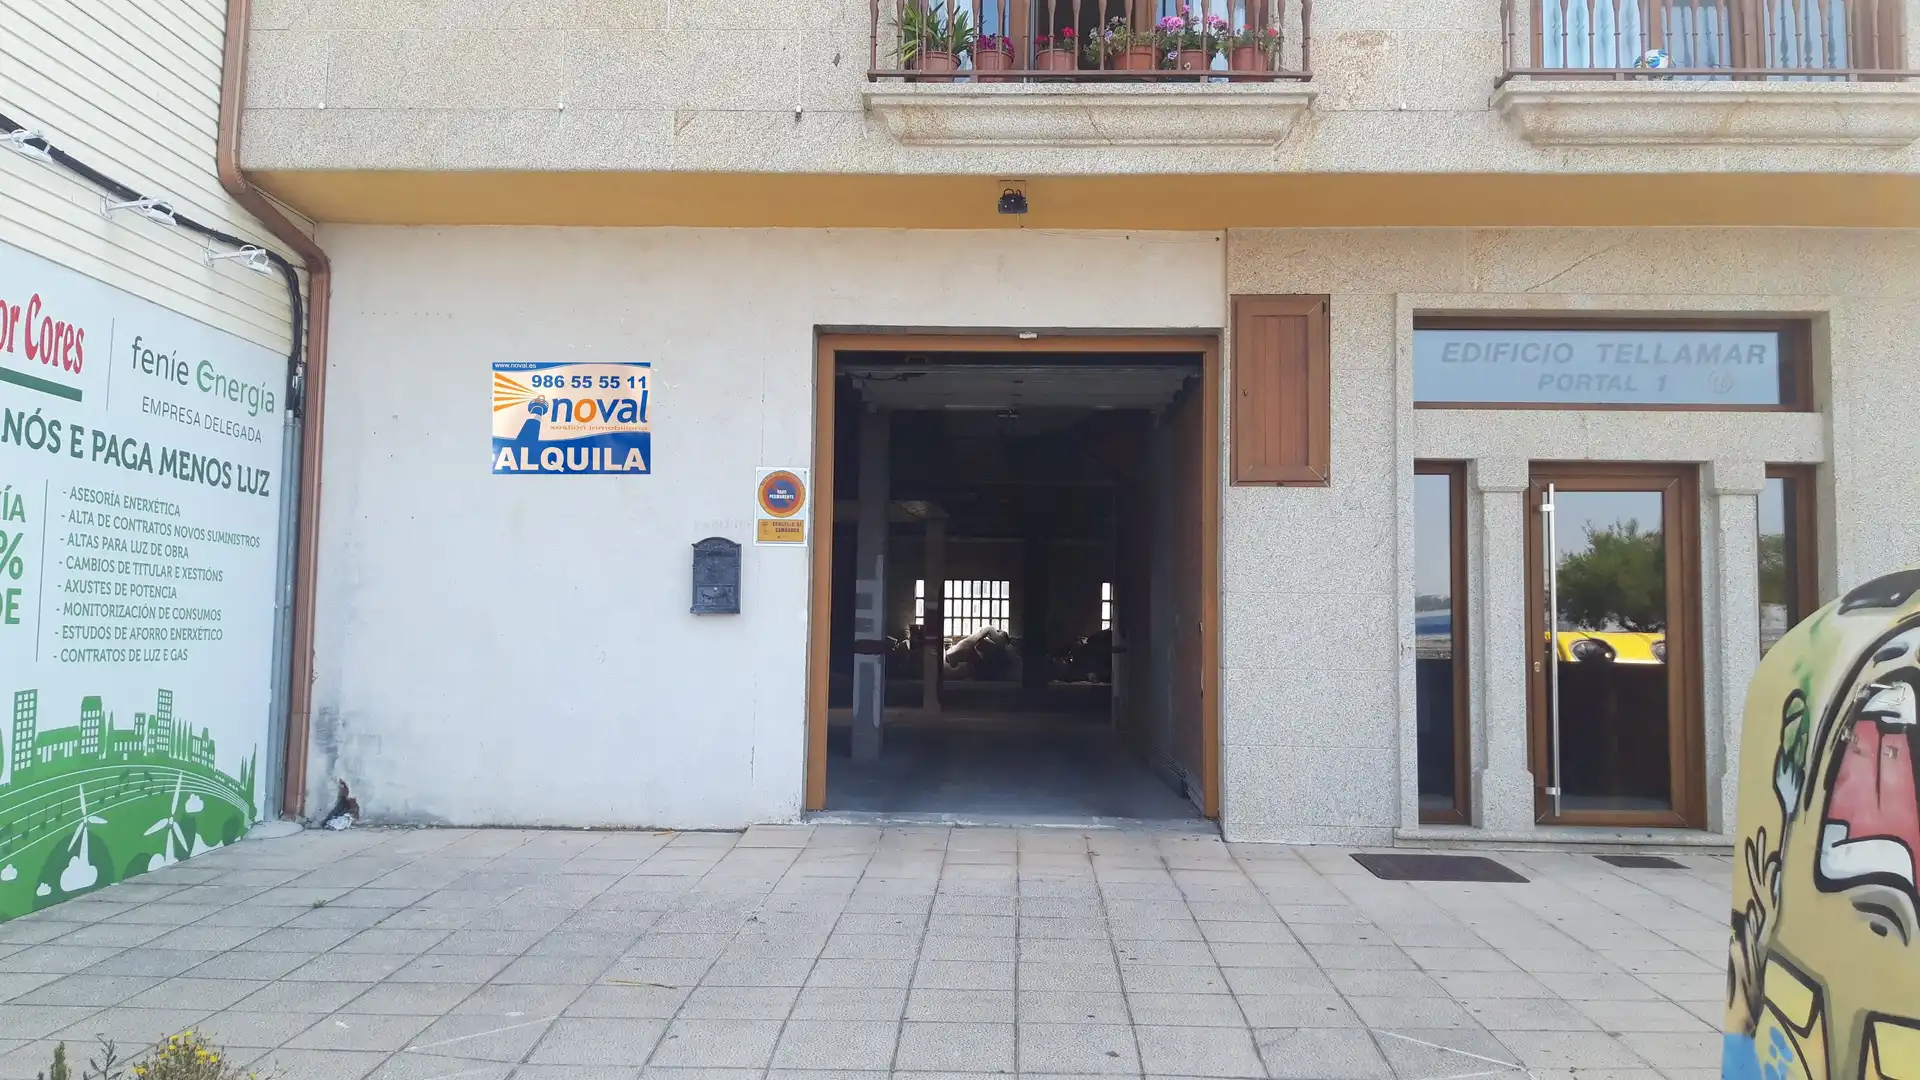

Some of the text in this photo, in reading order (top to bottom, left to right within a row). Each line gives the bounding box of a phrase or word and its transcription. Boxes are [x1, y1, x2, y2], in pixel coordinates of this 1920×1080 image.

[25, 293, 84, 374] Cores
[1441, 342, 1767, 365] EDIFICIO TELLAMAR
[531, 375, 646, 389] 986 55 55 11
[1538, 373, 1668, 392] PORTAL 1
[142, 396, 262, 443] EMPRESA DELEGADA
[550, 390, 649, 423] noval
[1, 407, 270, 497] NÓS E PAGA MENOS LUZ
[494, 447, 647, 473] ALQUILA
[0, 485, 26, 523] ÍA
[69, 486, 180, 517] ASESORÍA ENERXÉTICA
[68, 509, 260, 548] ALTA DE CONTRATOS NOVOS SUMINISTROS
[67, 532, 189, 559] ALTAS PARA LUZ DE OBRA
[66, 556, 223, 582] CAMBIOS DE TITULAR E XESTIÓNS
[64, 579, 178, 599] AXUSTES DE POTENCIA
[63, 602, 222, 621] MONITORIZACIÓN DE CONSUMOS
[62, 625, 223, 641] ESTUDOS DE AFORRO ENERXÉTICO
[60, 648, 188, 663] CONTRATOS DE LUZ E GAS
